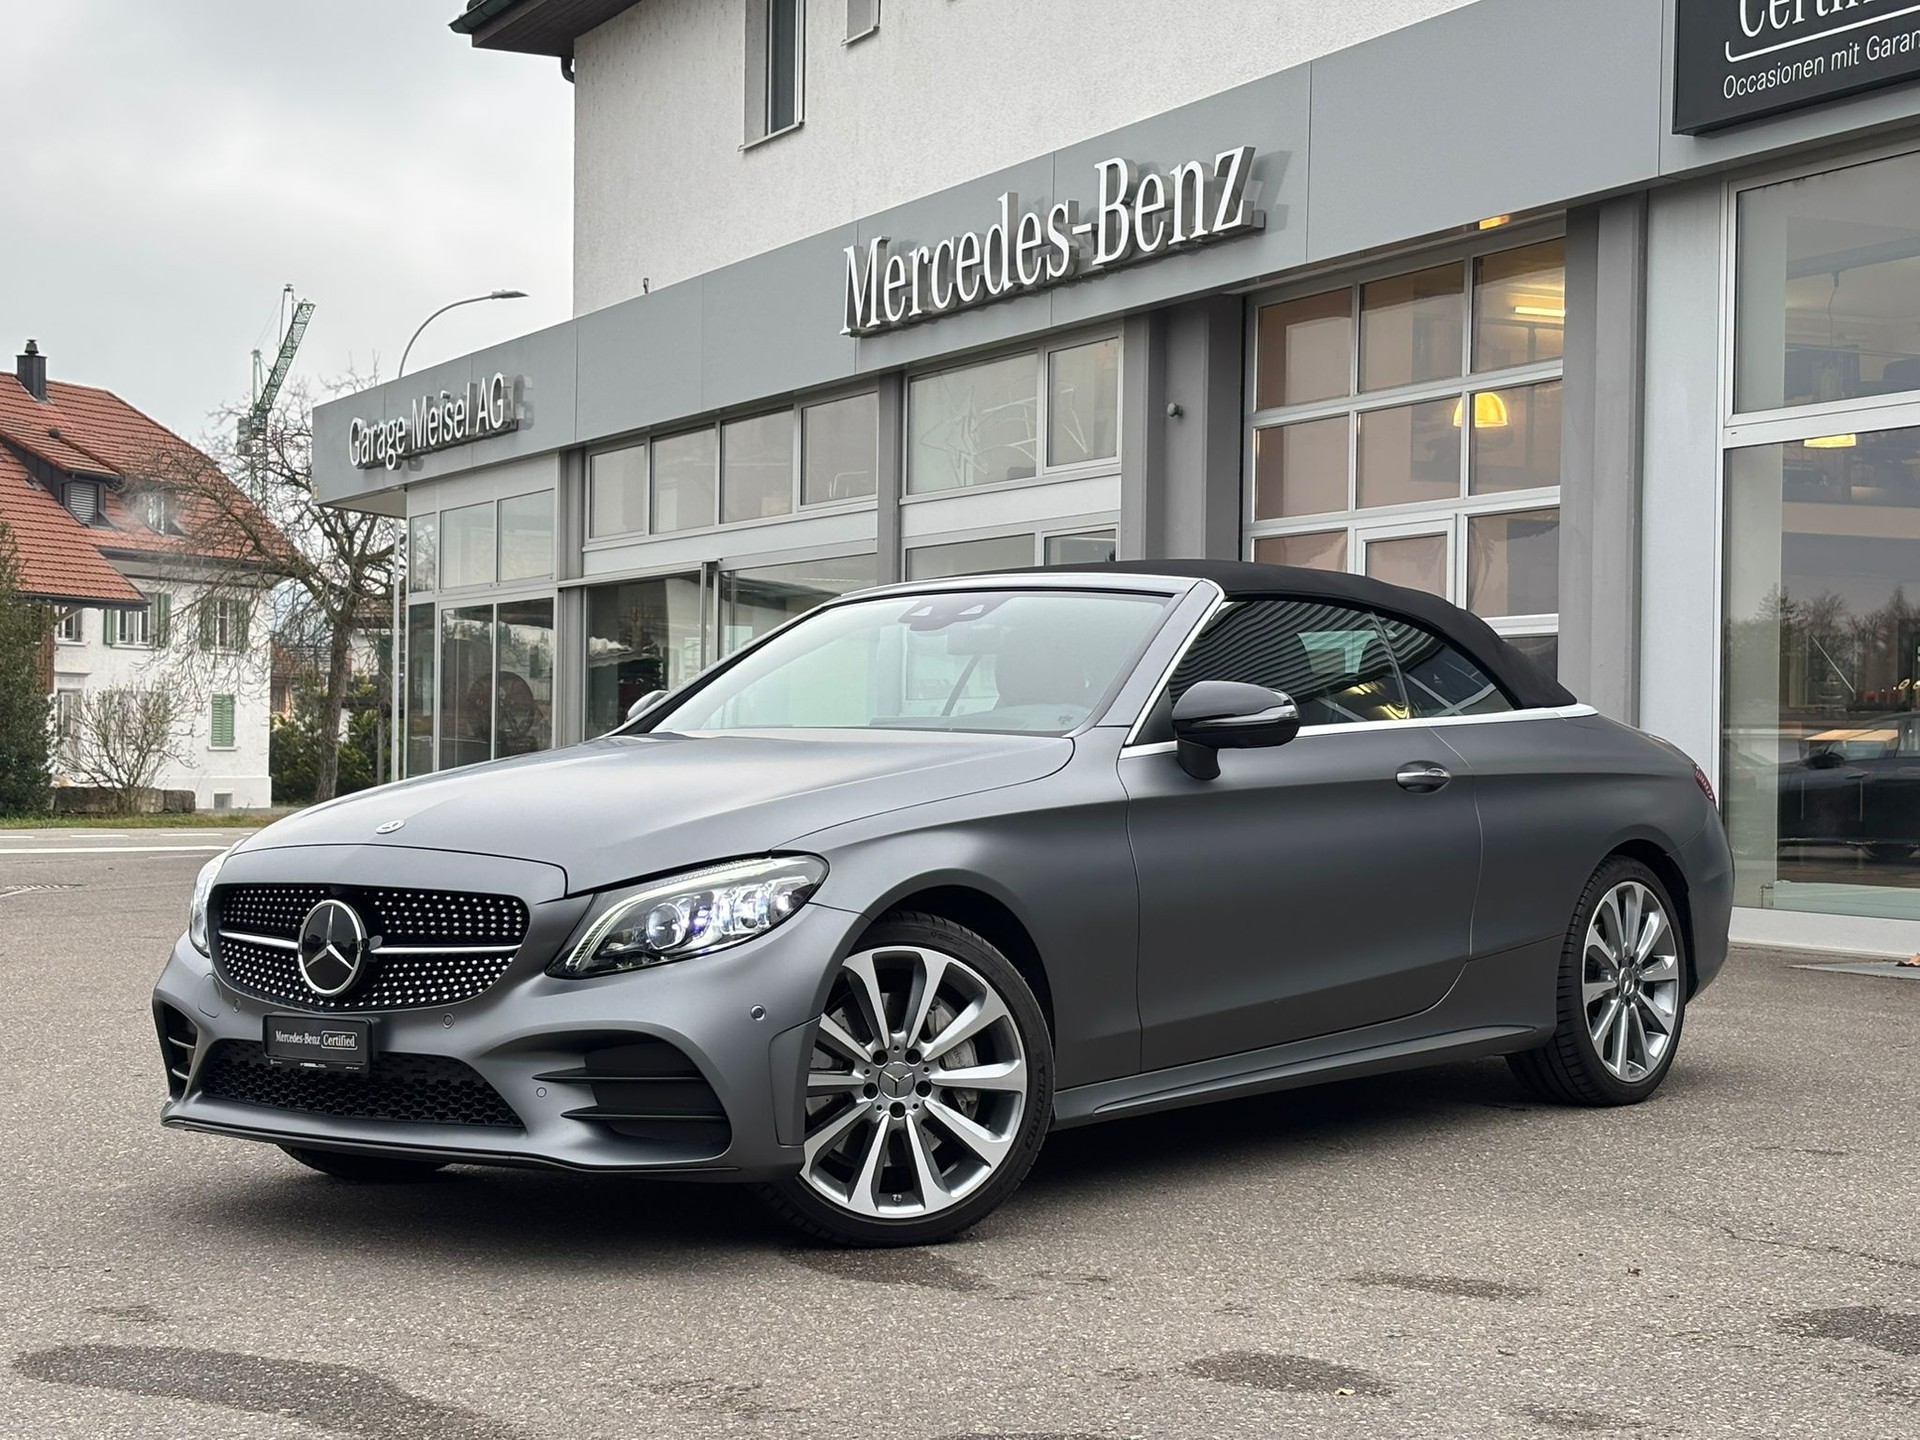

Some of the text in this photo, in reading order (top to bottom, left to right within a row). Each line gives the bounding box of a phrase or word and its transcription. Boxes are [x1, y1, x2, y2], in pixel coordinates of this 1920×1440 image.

[1723, 29, 1920, 99] Occasionen mit Garan
[840, 146, 1253, 335] Mercedes-Benz
[350, 372, 504, 471] Garage Meisel AG
[275, 1030, 355, 1047] Mercedes-Benz Certified
